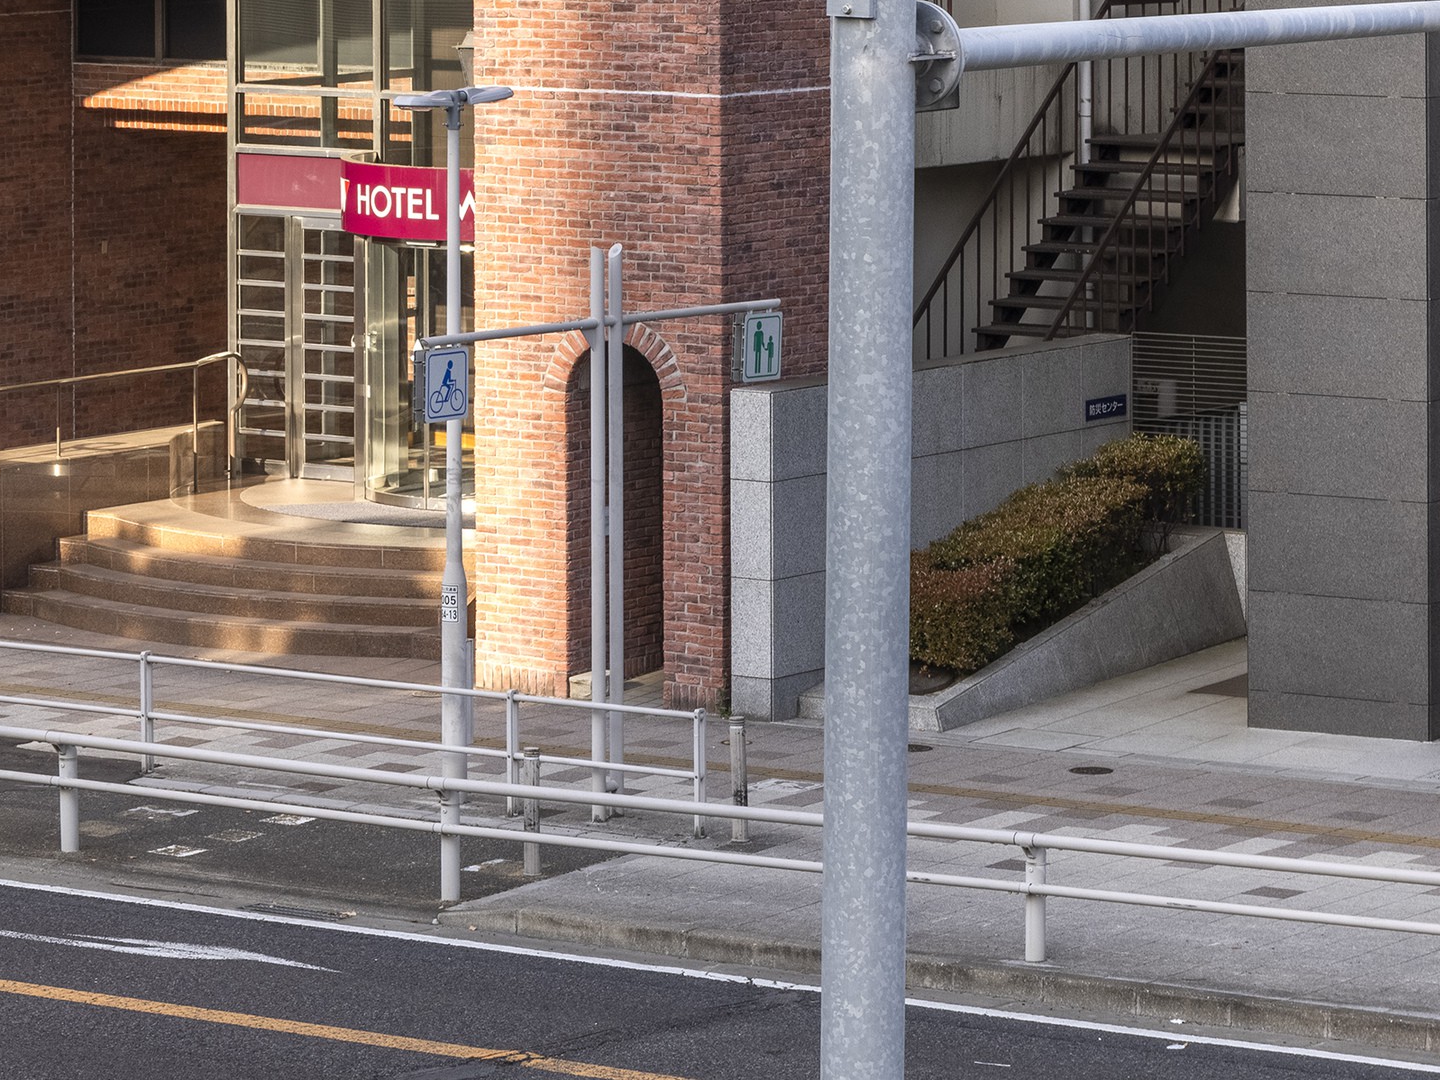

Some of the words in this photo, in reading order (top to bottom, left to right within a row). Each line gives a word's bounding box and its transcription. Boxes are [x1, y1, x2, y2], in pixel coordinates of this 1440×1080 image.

[357, 183, 439, 220] HOTEL
[1089, 401, 1124, 417] 防災センター
[442, 595, 457, 605] 05
